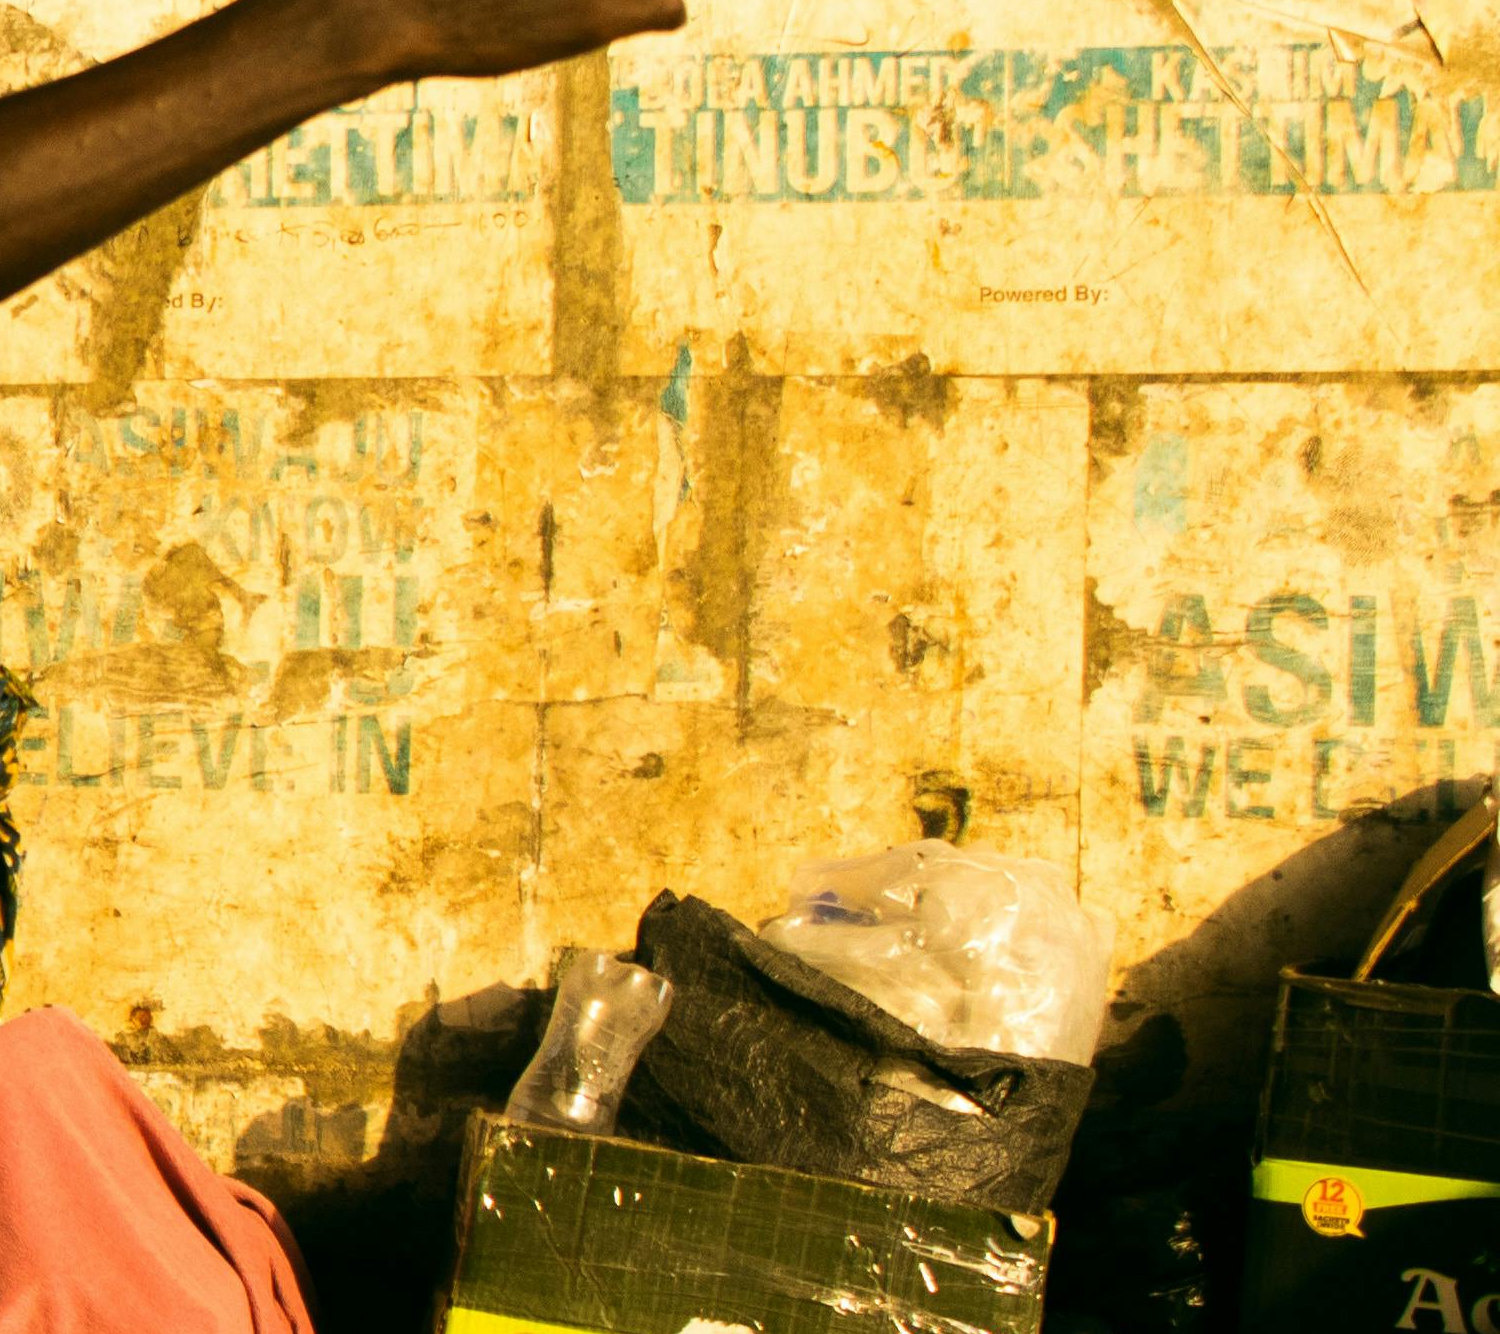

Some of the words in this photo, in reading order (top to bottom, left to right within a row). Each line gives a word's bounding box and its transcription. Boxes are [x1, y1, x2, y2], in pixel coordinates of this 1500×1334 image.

[783, 51, 962, 109] AHMED
[1150, 43, 1360, 104] KASHIM
[639, 110, 978, 201] TINUBU
[1031, 97, 1462, 199] SHETTIMA
[189, 293, 224, 313] By:
[979, 285, 1067, 304] Powered
[1074, 285, 1109, 306] By:
[329, 713, 413, 796] IN
[1135, 736, 1275, 821] WE
[1319, 1178, 1345, 1203] 12
